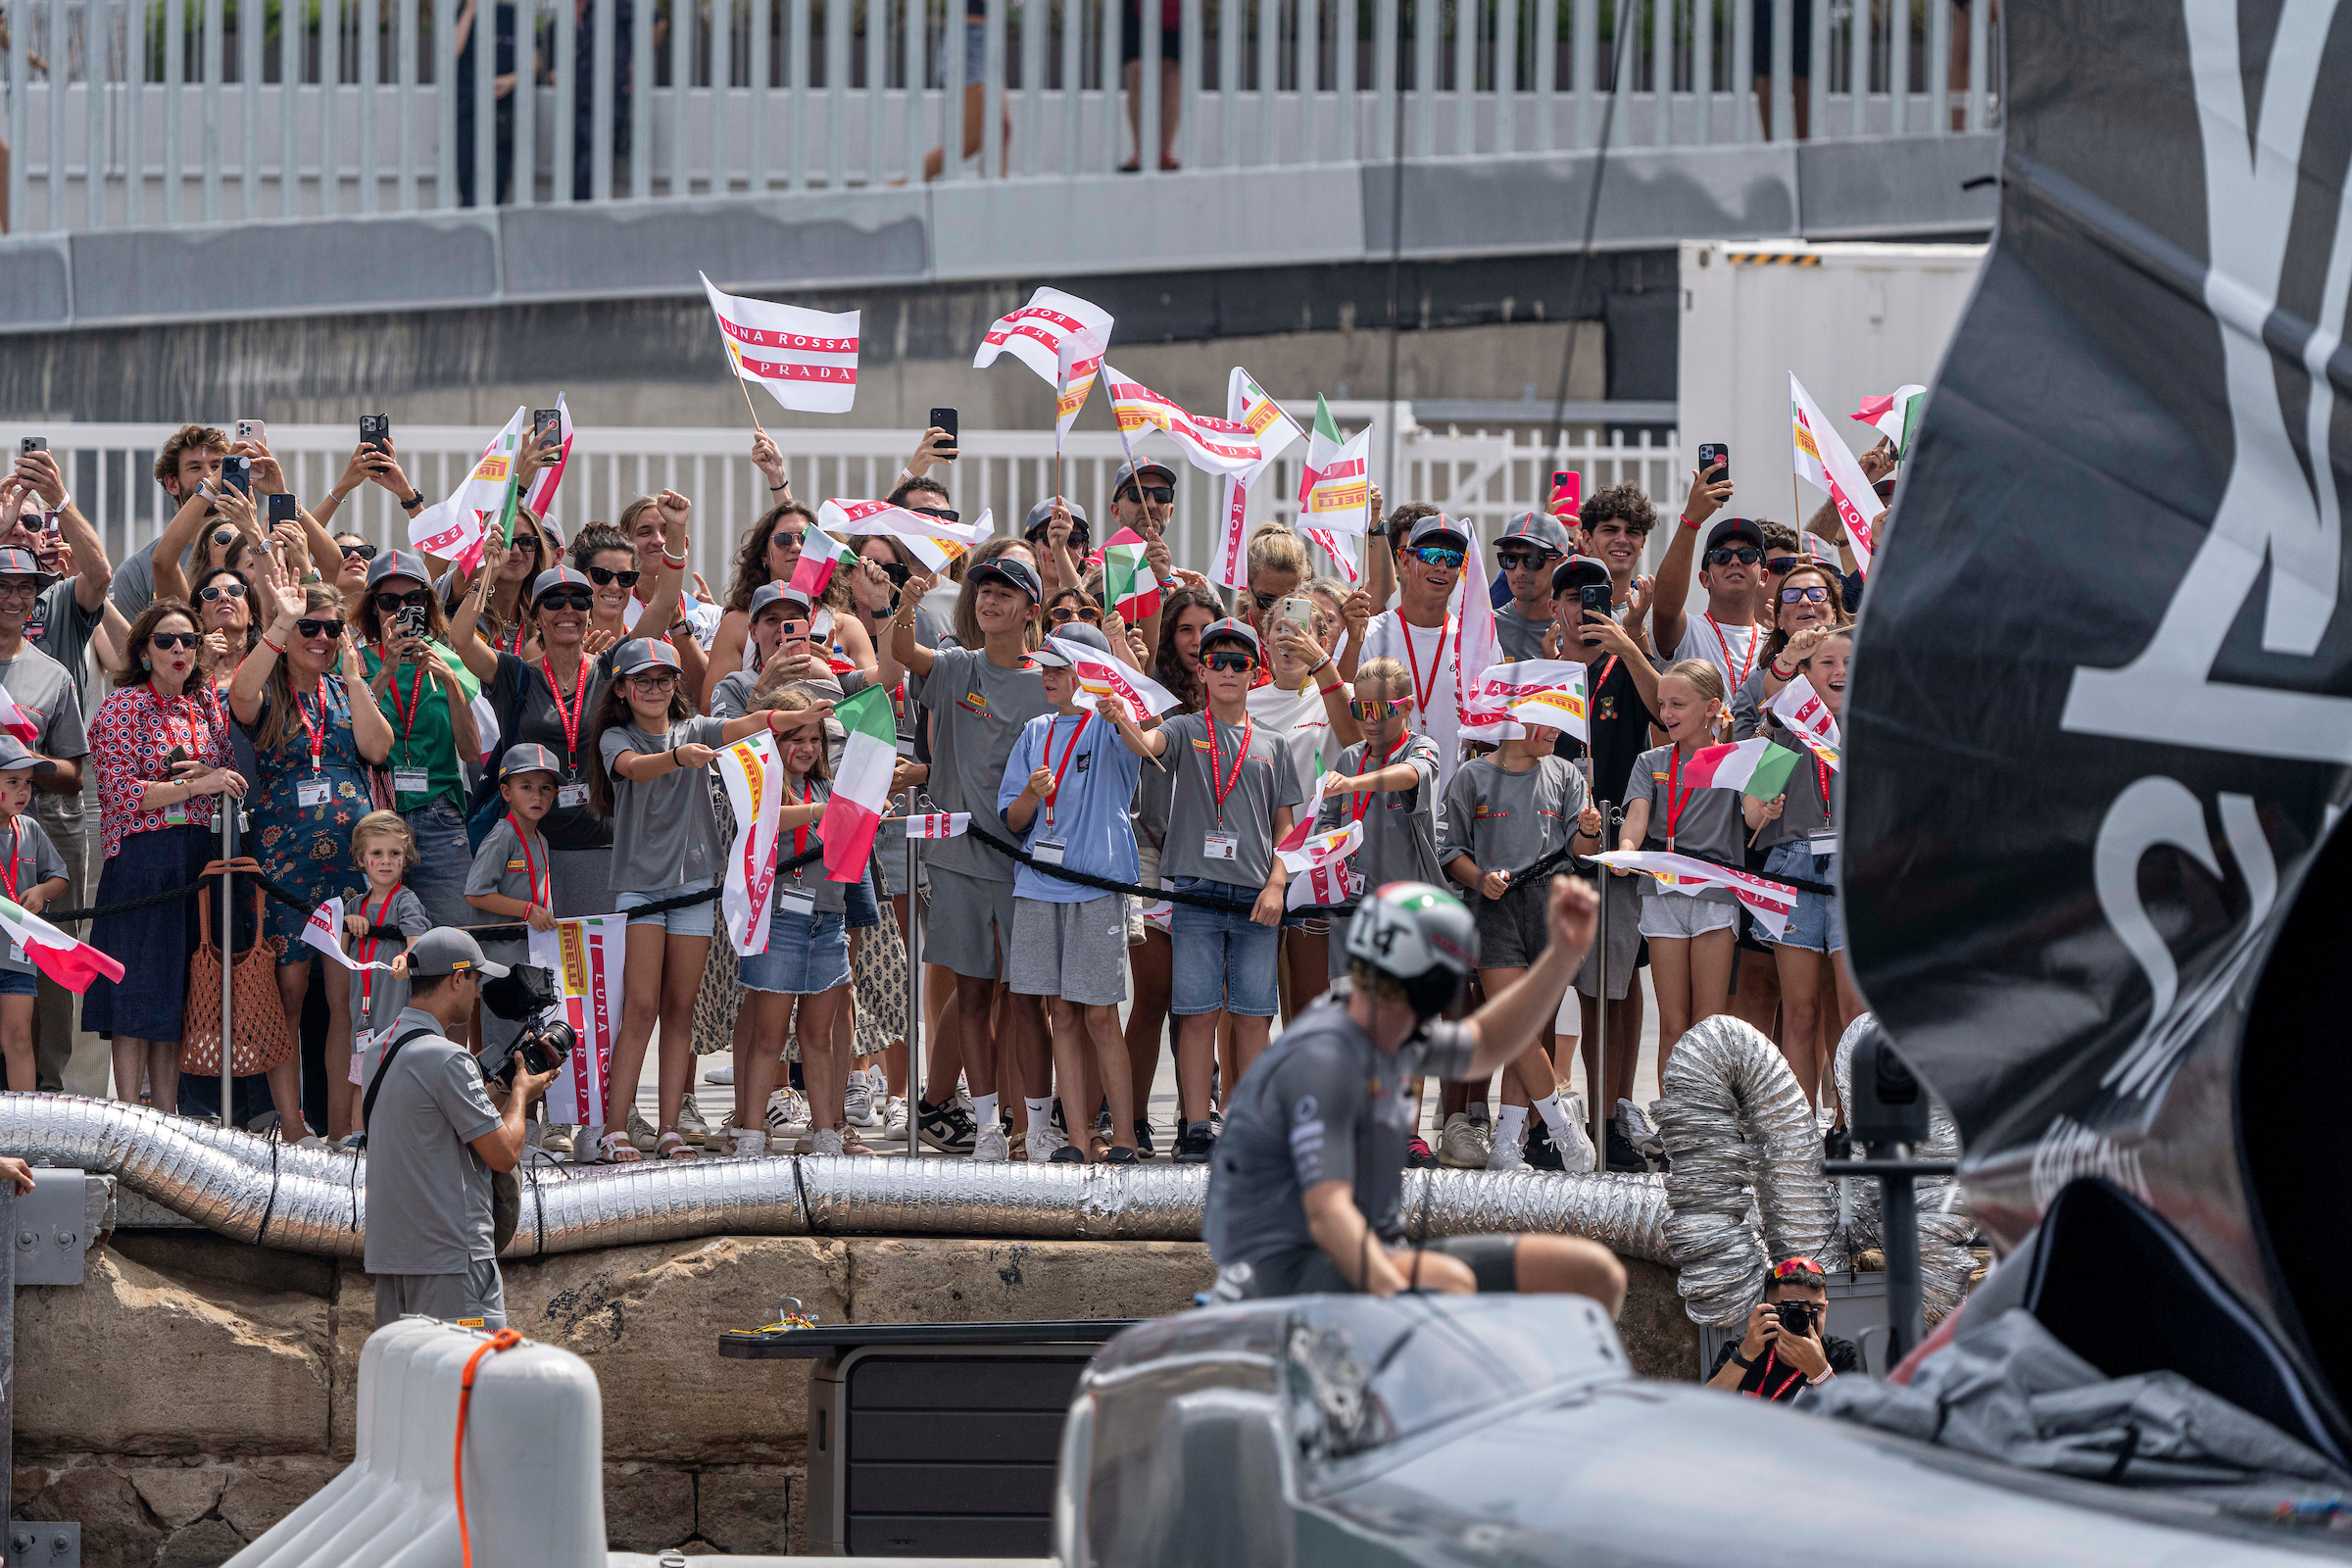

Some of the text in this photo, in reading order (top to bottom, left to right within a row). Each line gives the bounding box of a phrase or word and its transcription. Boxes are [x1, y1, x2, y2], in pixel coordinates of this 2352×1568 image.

[724, 319, 852, 349] LUNA ROSSA
[760, 363, 851, 379] PRADA
[1102, 666, 1134, 698] LUNA
[737, 748, 762, 814] PIRELLI
[563, 923, 584, 988] PIRELLI
[595, 973, 608, 1033] LUNA
[574, 1028, 589, 1118] PRADA
